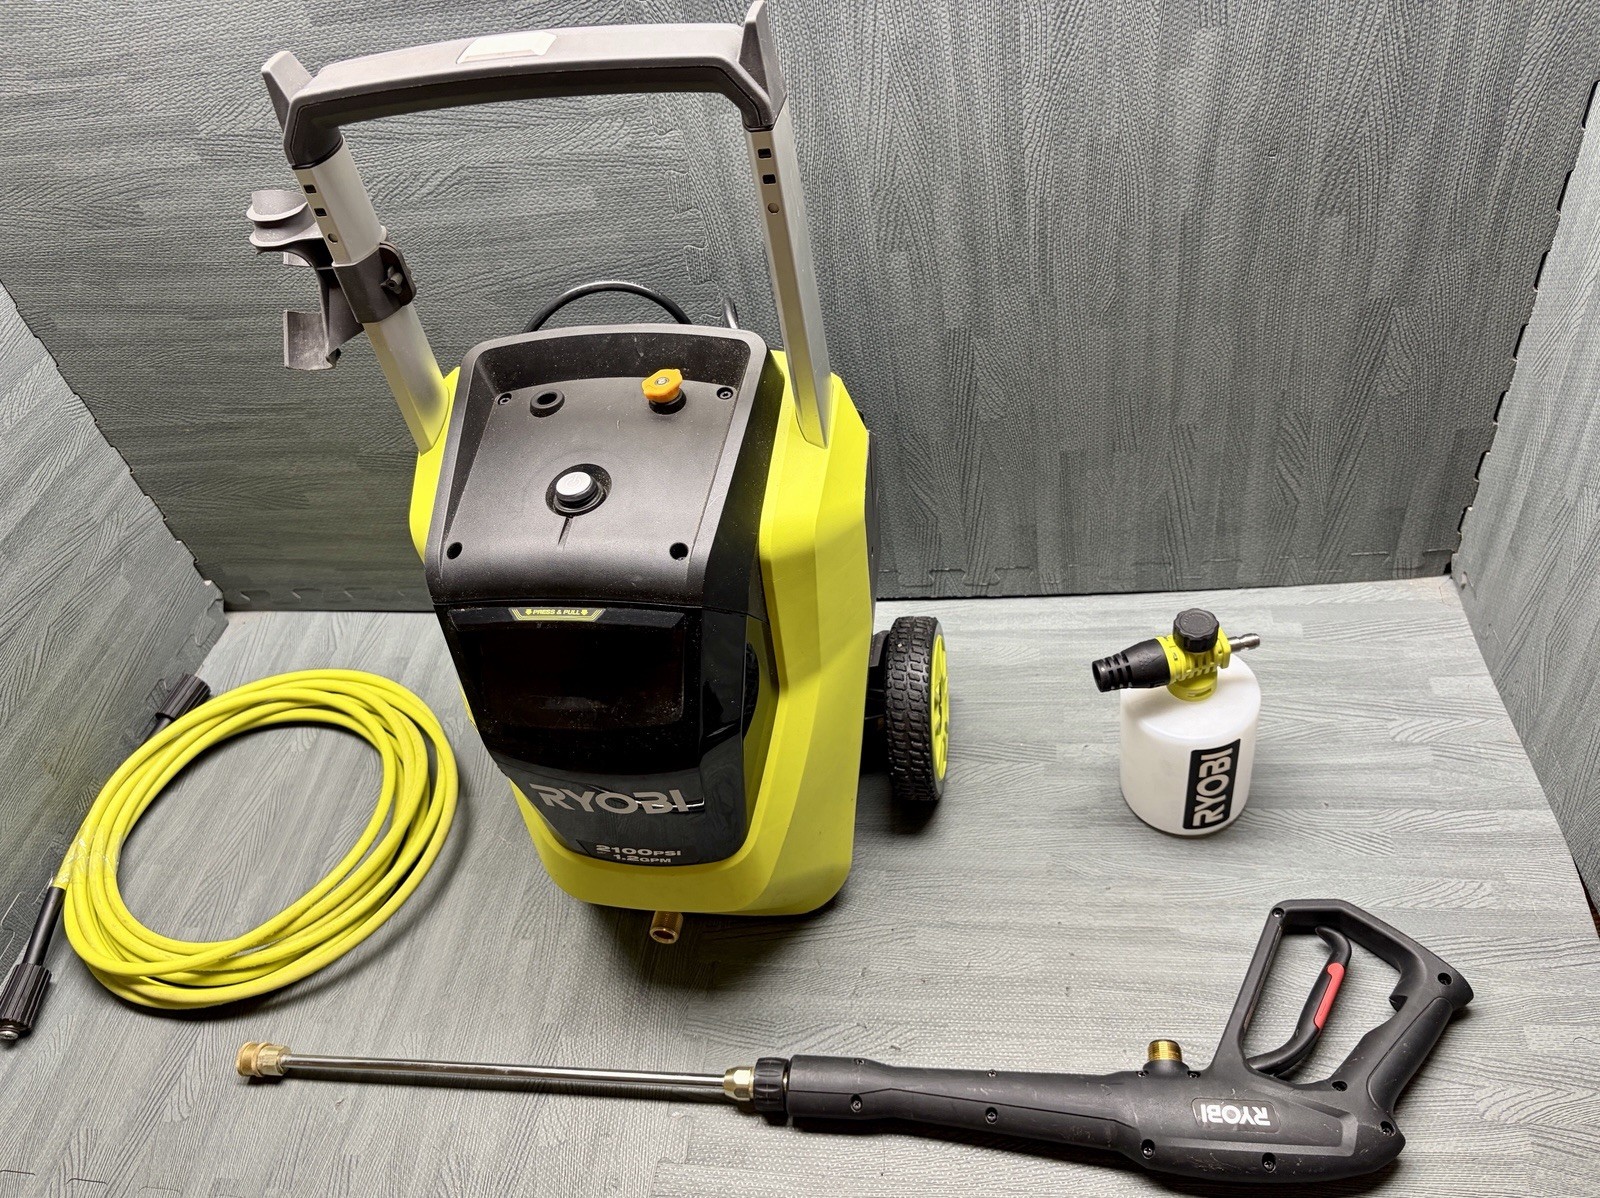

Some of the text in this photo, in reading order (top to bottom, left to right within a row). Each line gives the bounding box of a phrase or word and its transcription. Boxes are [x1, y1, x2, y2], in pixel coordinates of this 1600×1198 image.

[532, 608, 555, 616] PRESS
[563, 608, 581, 616] PULL
[529, 783, 690, 815] RYOBI
[1192, 748, 1233, 827] RYOBI
[596, 844, 682, 857] 2100PSI
[1200, 1103, 1271, 1126] RYOBI
